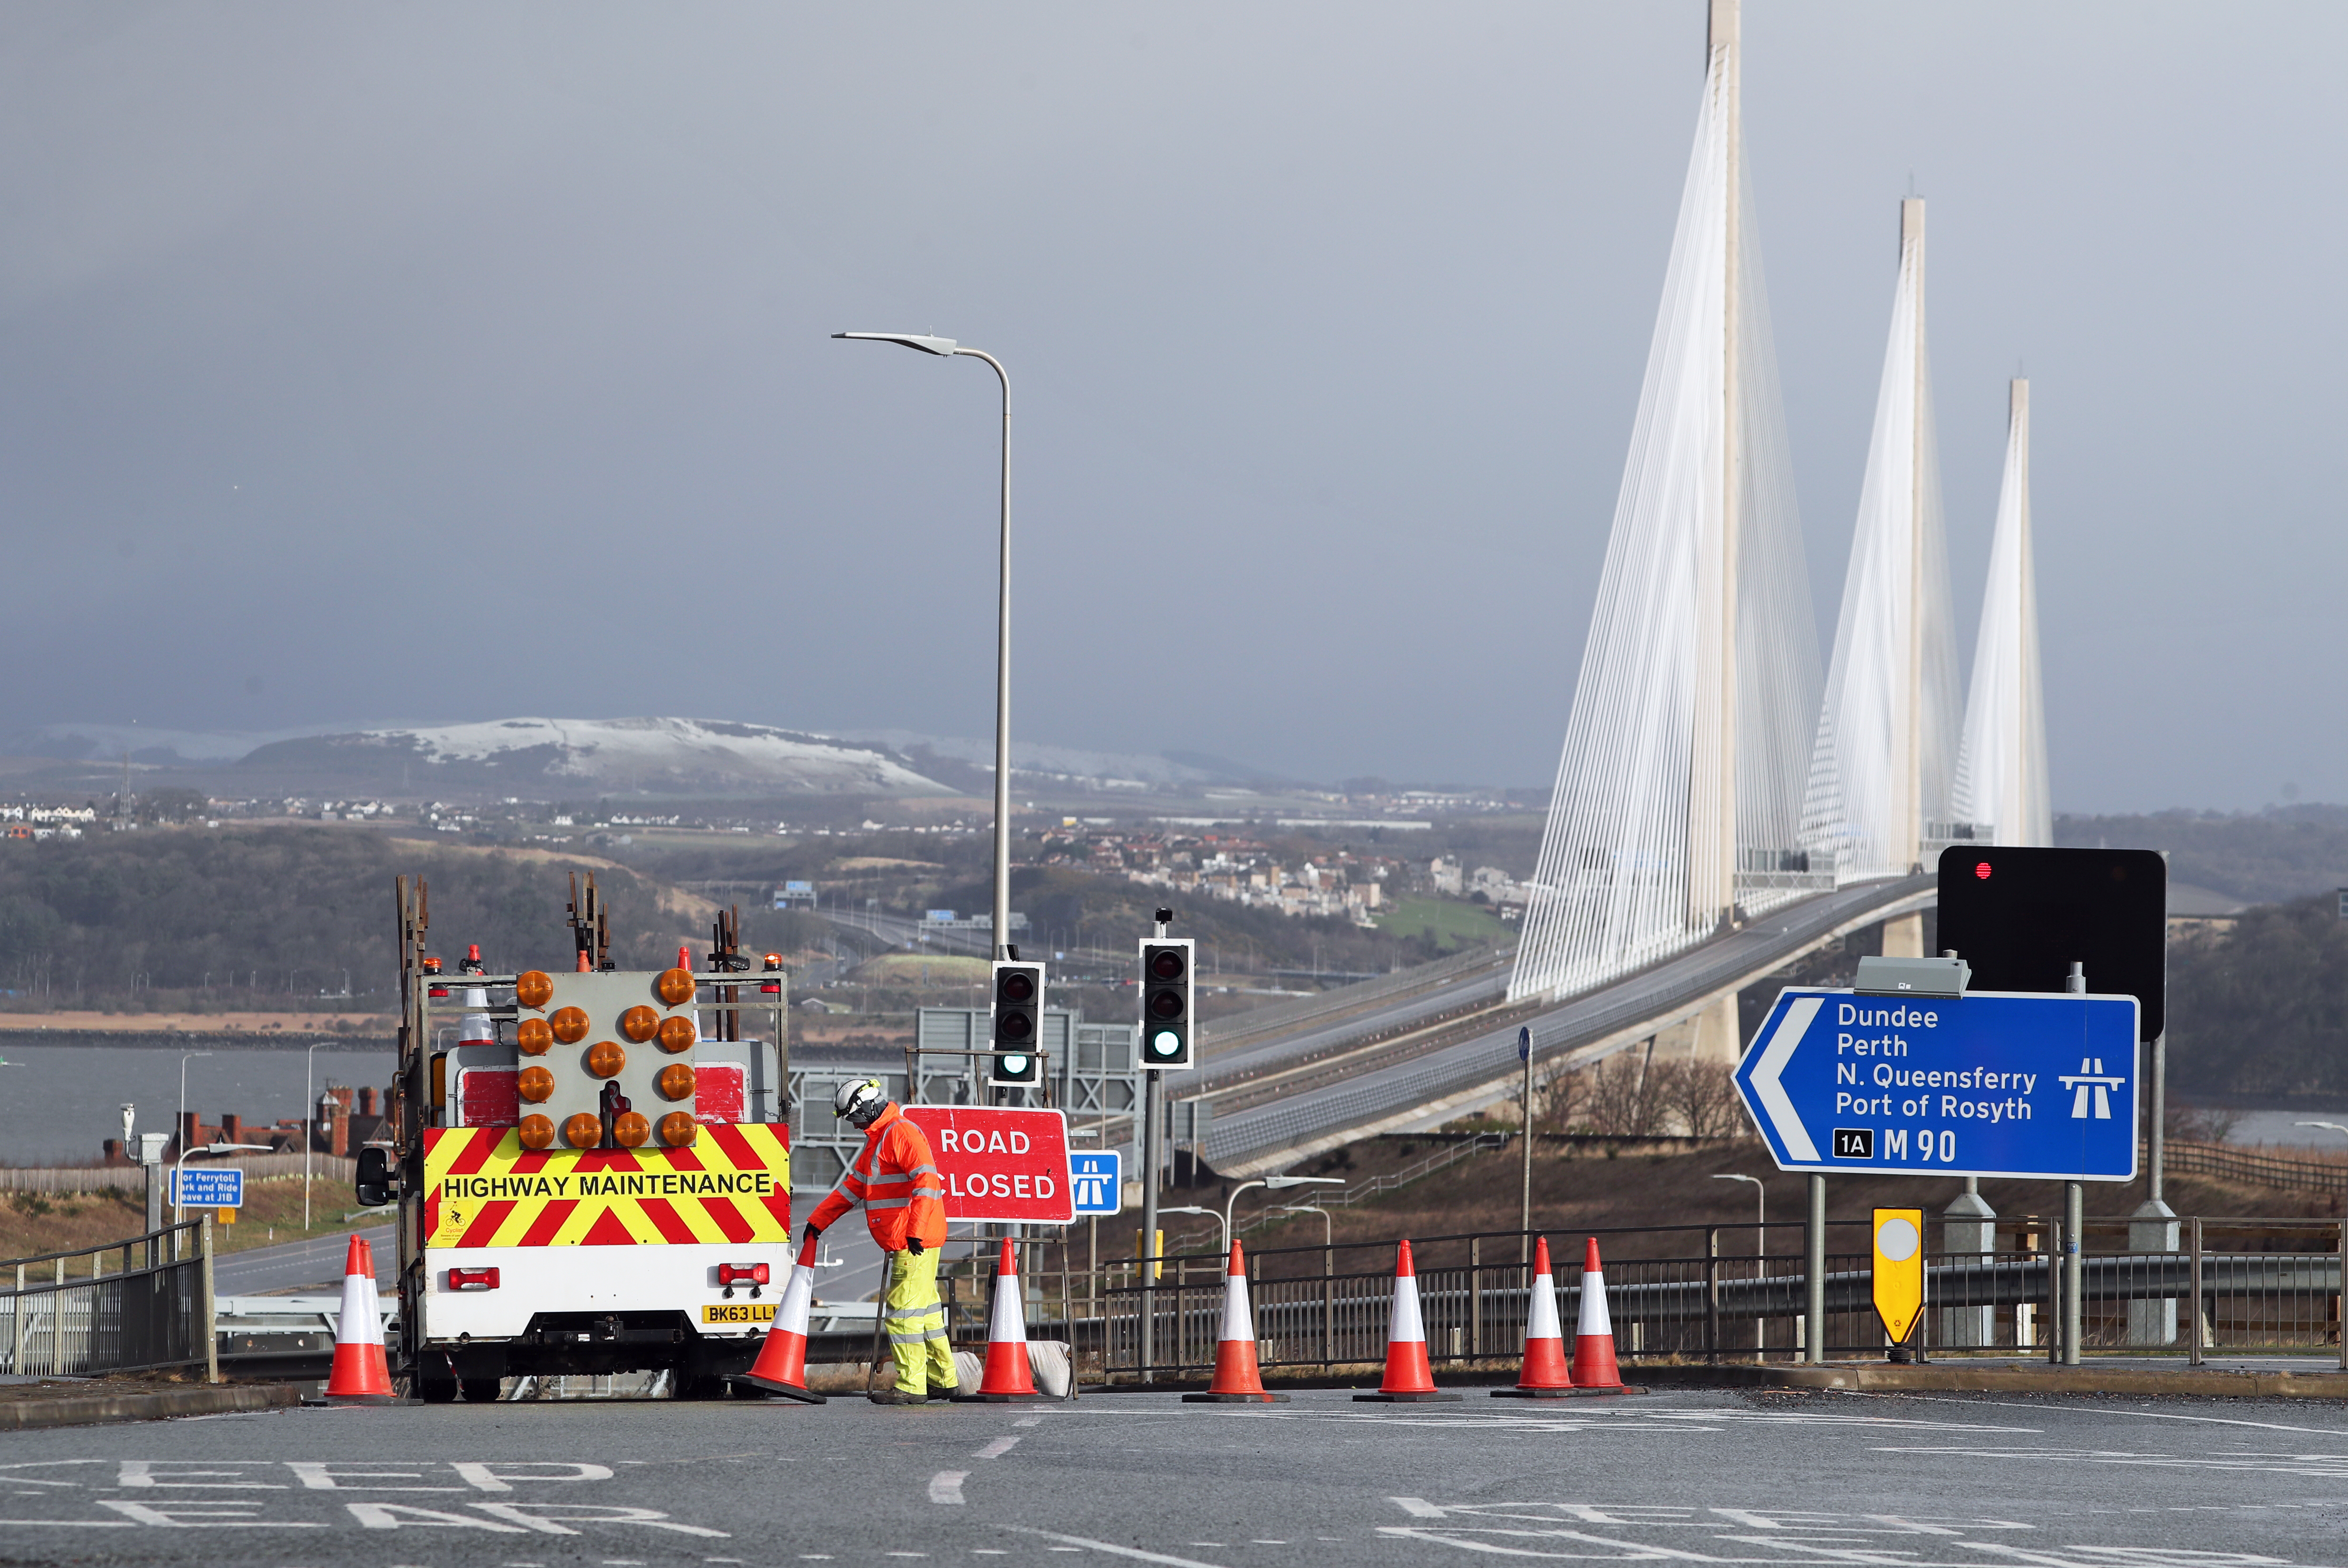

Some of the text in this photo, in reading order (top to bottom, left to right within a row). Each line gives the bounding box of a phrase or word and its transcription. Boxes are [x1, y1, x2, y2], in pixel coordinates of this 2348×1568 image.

[1839, 1003, 1939, 1028] Dundee
[1838, 1033, 1908, 1057] Perth
[1837, 1062, 2037, 1095] N. Queensferry
[1836, 1092, 2032, 1123] Port of Rosyth
[940, 1129, 1030, 1154] ROAD
[1841, 1134, 1865, 1153] 1A
[182, 1183, 238, 1193] ark and Ride
[196, 1172, 235, 1184] Ferrytoll
[445, 1173, 771, 1198] HIGHWAY MAINTENANCE
[181, 1193, 232, 1202] eave at J1B
[709, 1307, 748, 1321] BK63
[1387, 1497, 2037, 1535] KEEP
